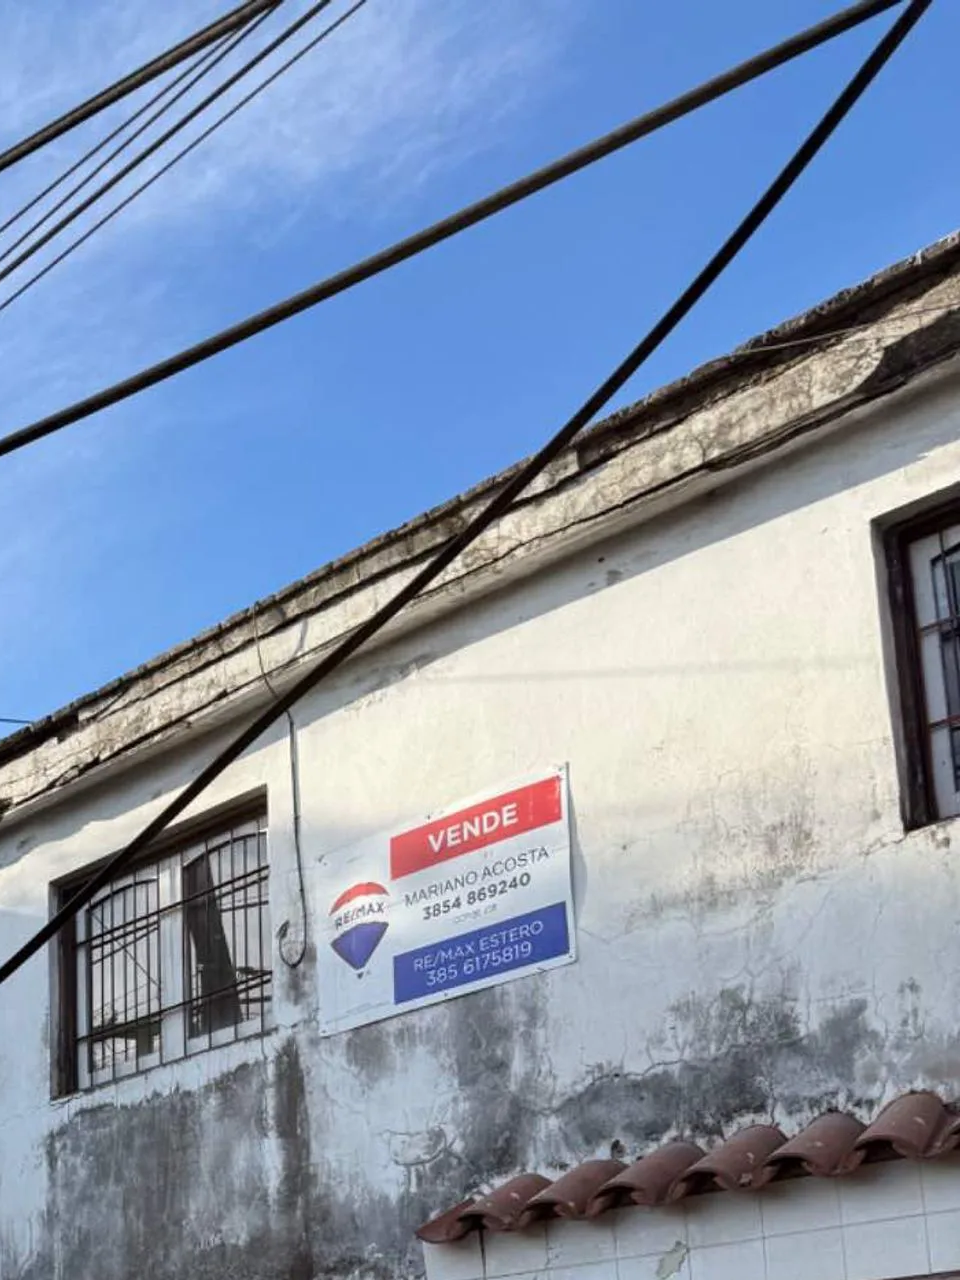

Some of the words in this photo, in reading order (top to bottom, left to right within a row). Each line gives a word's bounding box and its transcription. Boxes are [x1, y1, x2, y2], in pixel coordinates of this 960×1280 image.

[427, 803, 519, 853] VENDE
[404, 870, 477, 908] MARIANO
[481, 845, 549, 881] ACOSTA
[422, 900, 462, 921] 3854
[467, 873, 531, 907] 869240
[334, 902, 385, 928] RE/MAX
[413, 941, 475, 972] RE/MAX
[479, 920, 543, 951] ESTERO
[426, 963, 458, 987] 385
[462, 941, 532, 975] 6175819
